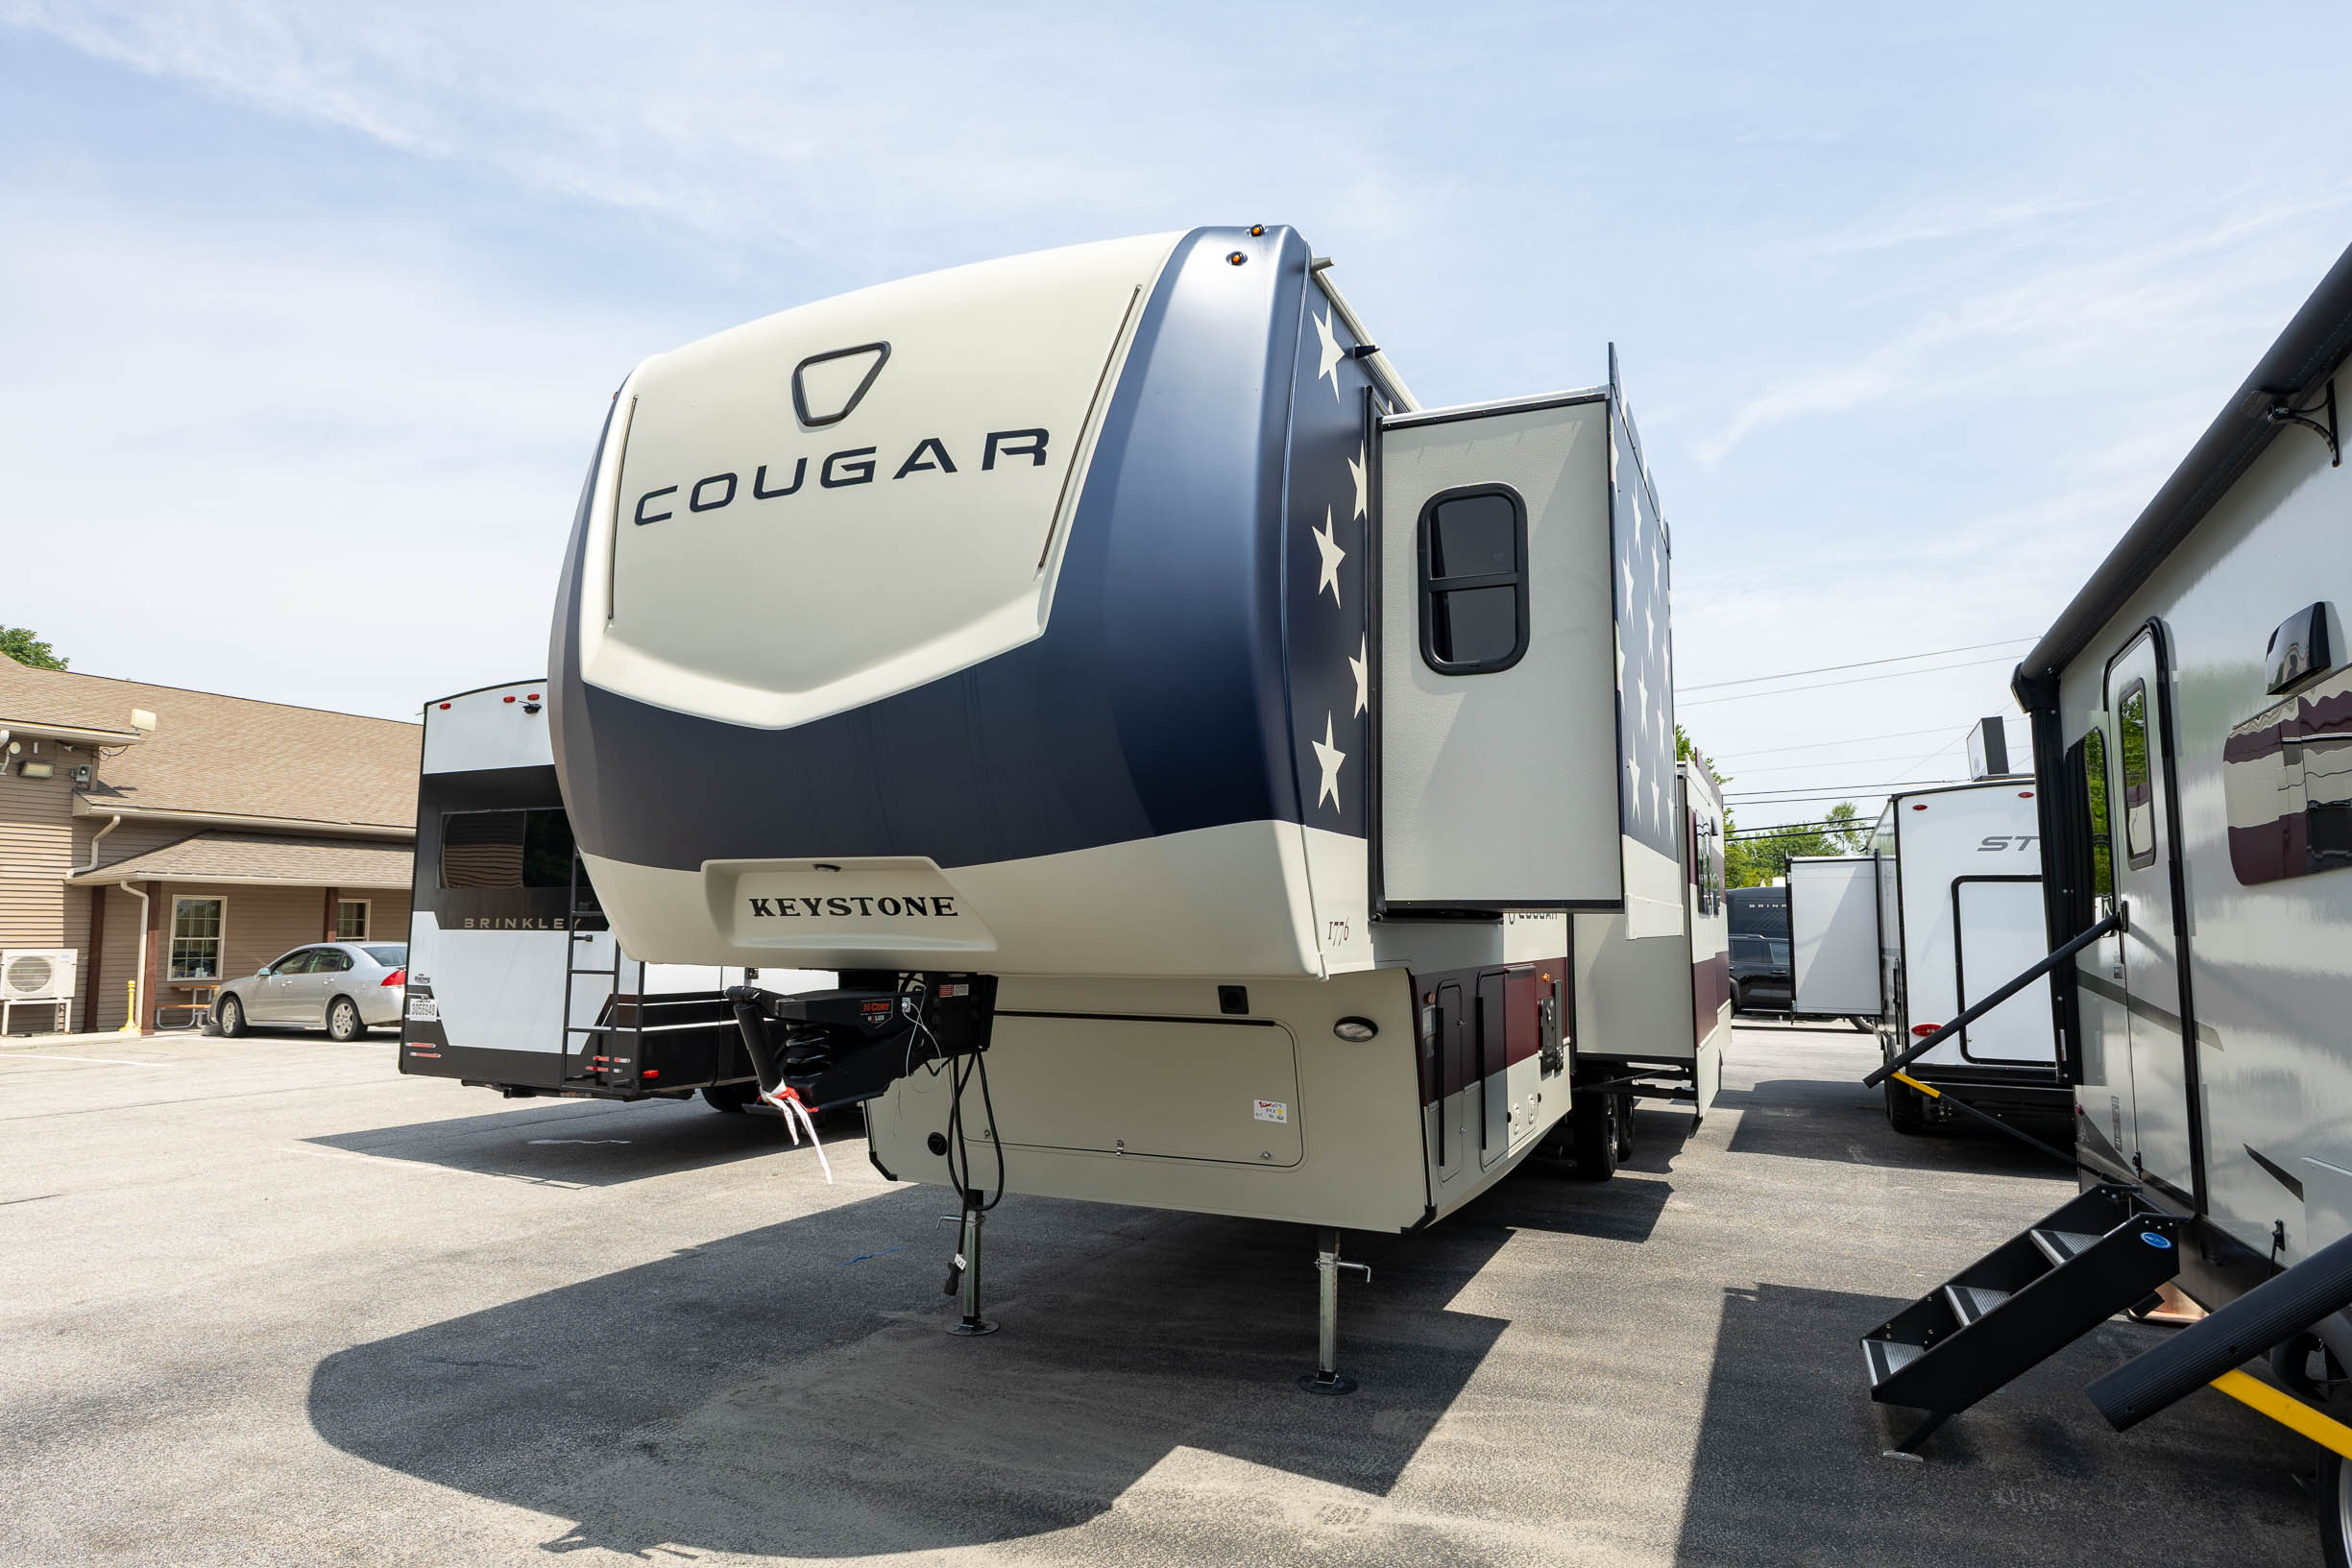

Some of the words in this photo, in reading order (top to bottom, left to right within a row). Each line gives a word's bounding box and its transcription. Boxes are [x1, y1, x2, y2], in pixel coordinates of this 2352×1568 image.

[634, 427, 1050, 526] COUGAR
[1976, 835, 2041, 852] ST
[748, 896, 958, 917] KEYSTONE
[464, 918, 581, 929] BRINKLEY
[1327, 915, 1349, 947] 1776
